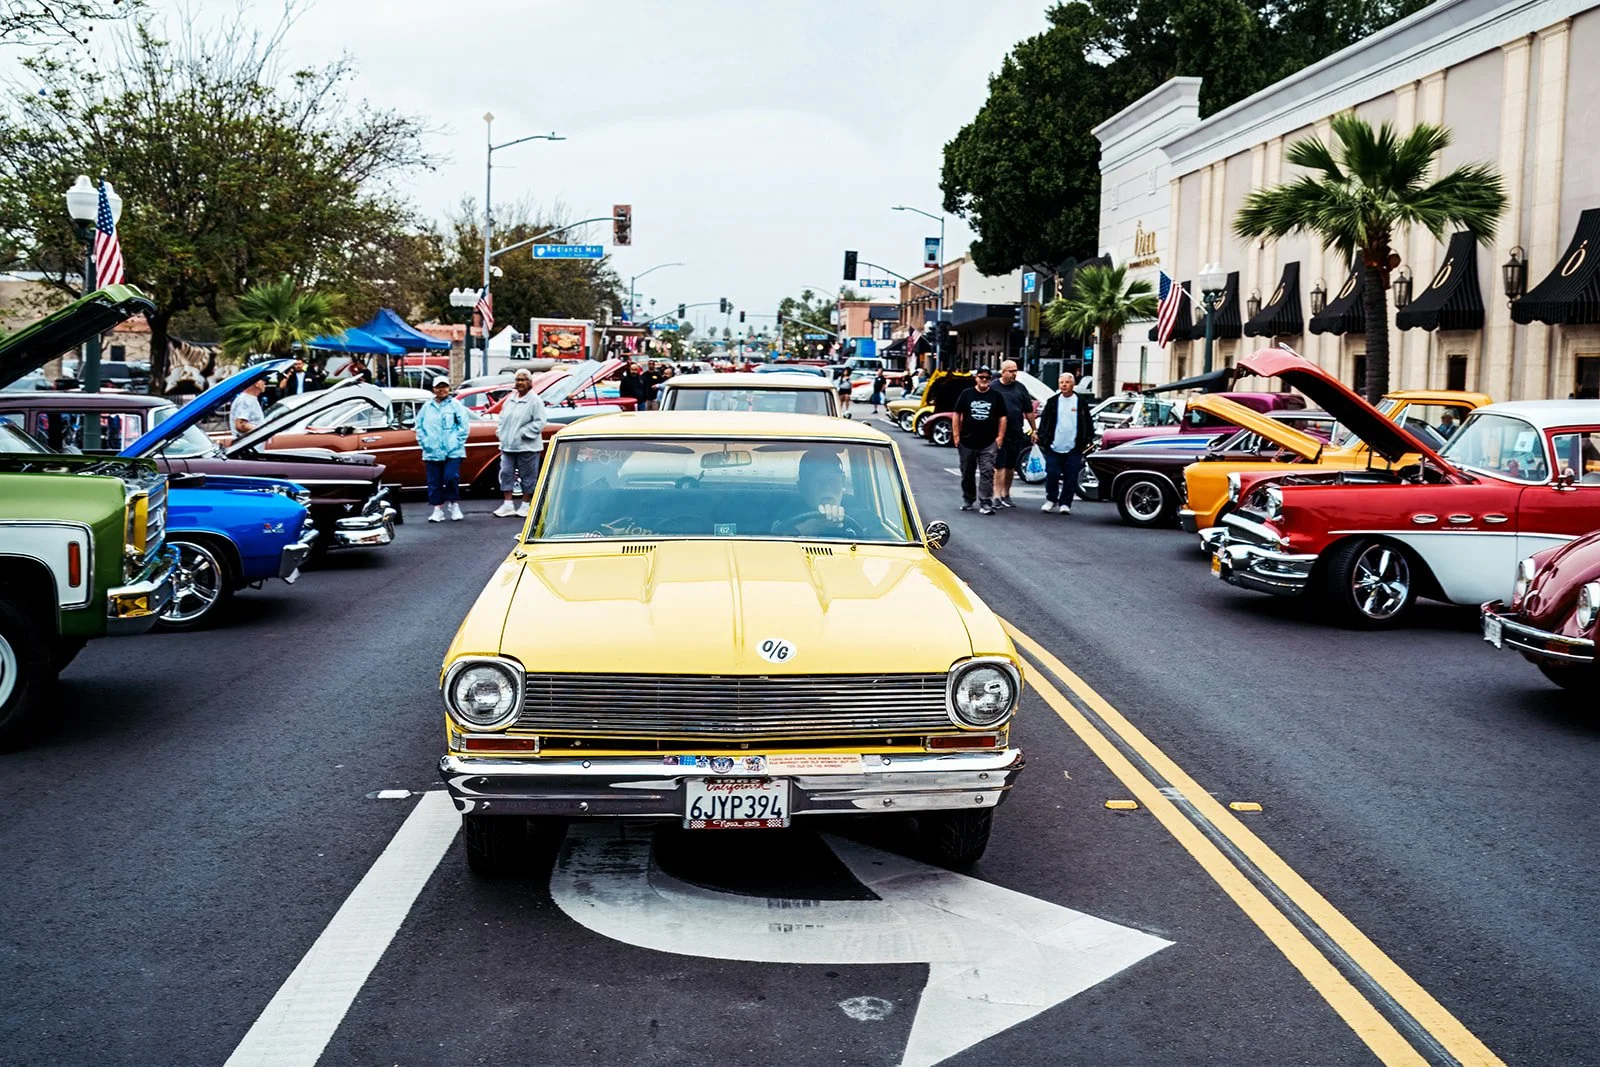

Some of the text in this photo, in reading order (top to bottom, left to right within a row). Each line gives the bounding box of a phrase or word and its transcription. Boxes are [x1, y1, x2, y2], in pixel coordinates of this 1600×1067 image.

[546, 245, 582, 253] Redlands
[762, 640, 789, 660] O/G
[706, 781, 771, 794] California
[690, 795, 782, 819] 6JYP394
